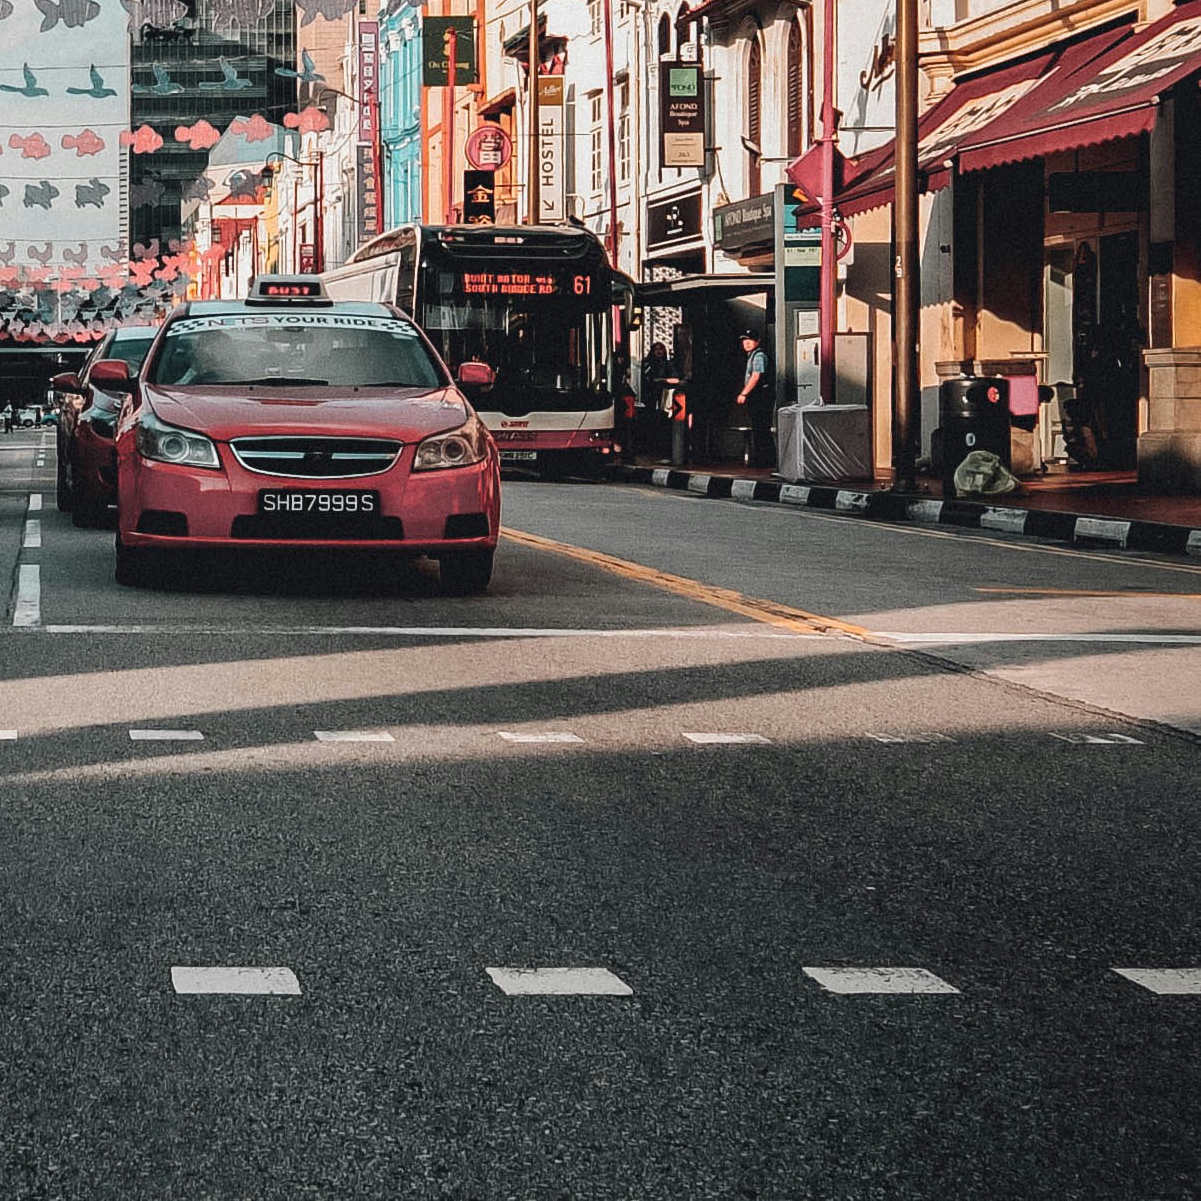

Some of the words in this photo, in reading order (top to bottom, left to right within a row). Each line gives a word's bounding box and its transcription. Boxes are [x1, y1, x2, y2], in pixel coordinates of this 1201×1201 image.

[541, 118, 554, 187] HOSTEL
[574, 275, 591, 294] 61
[207, 316, 269, 327] NETS
[273, 316, 328, 325] YOUR
[333, 318, 379, 327] RIDE
[263, 494, 374, 511] SHB7999S
